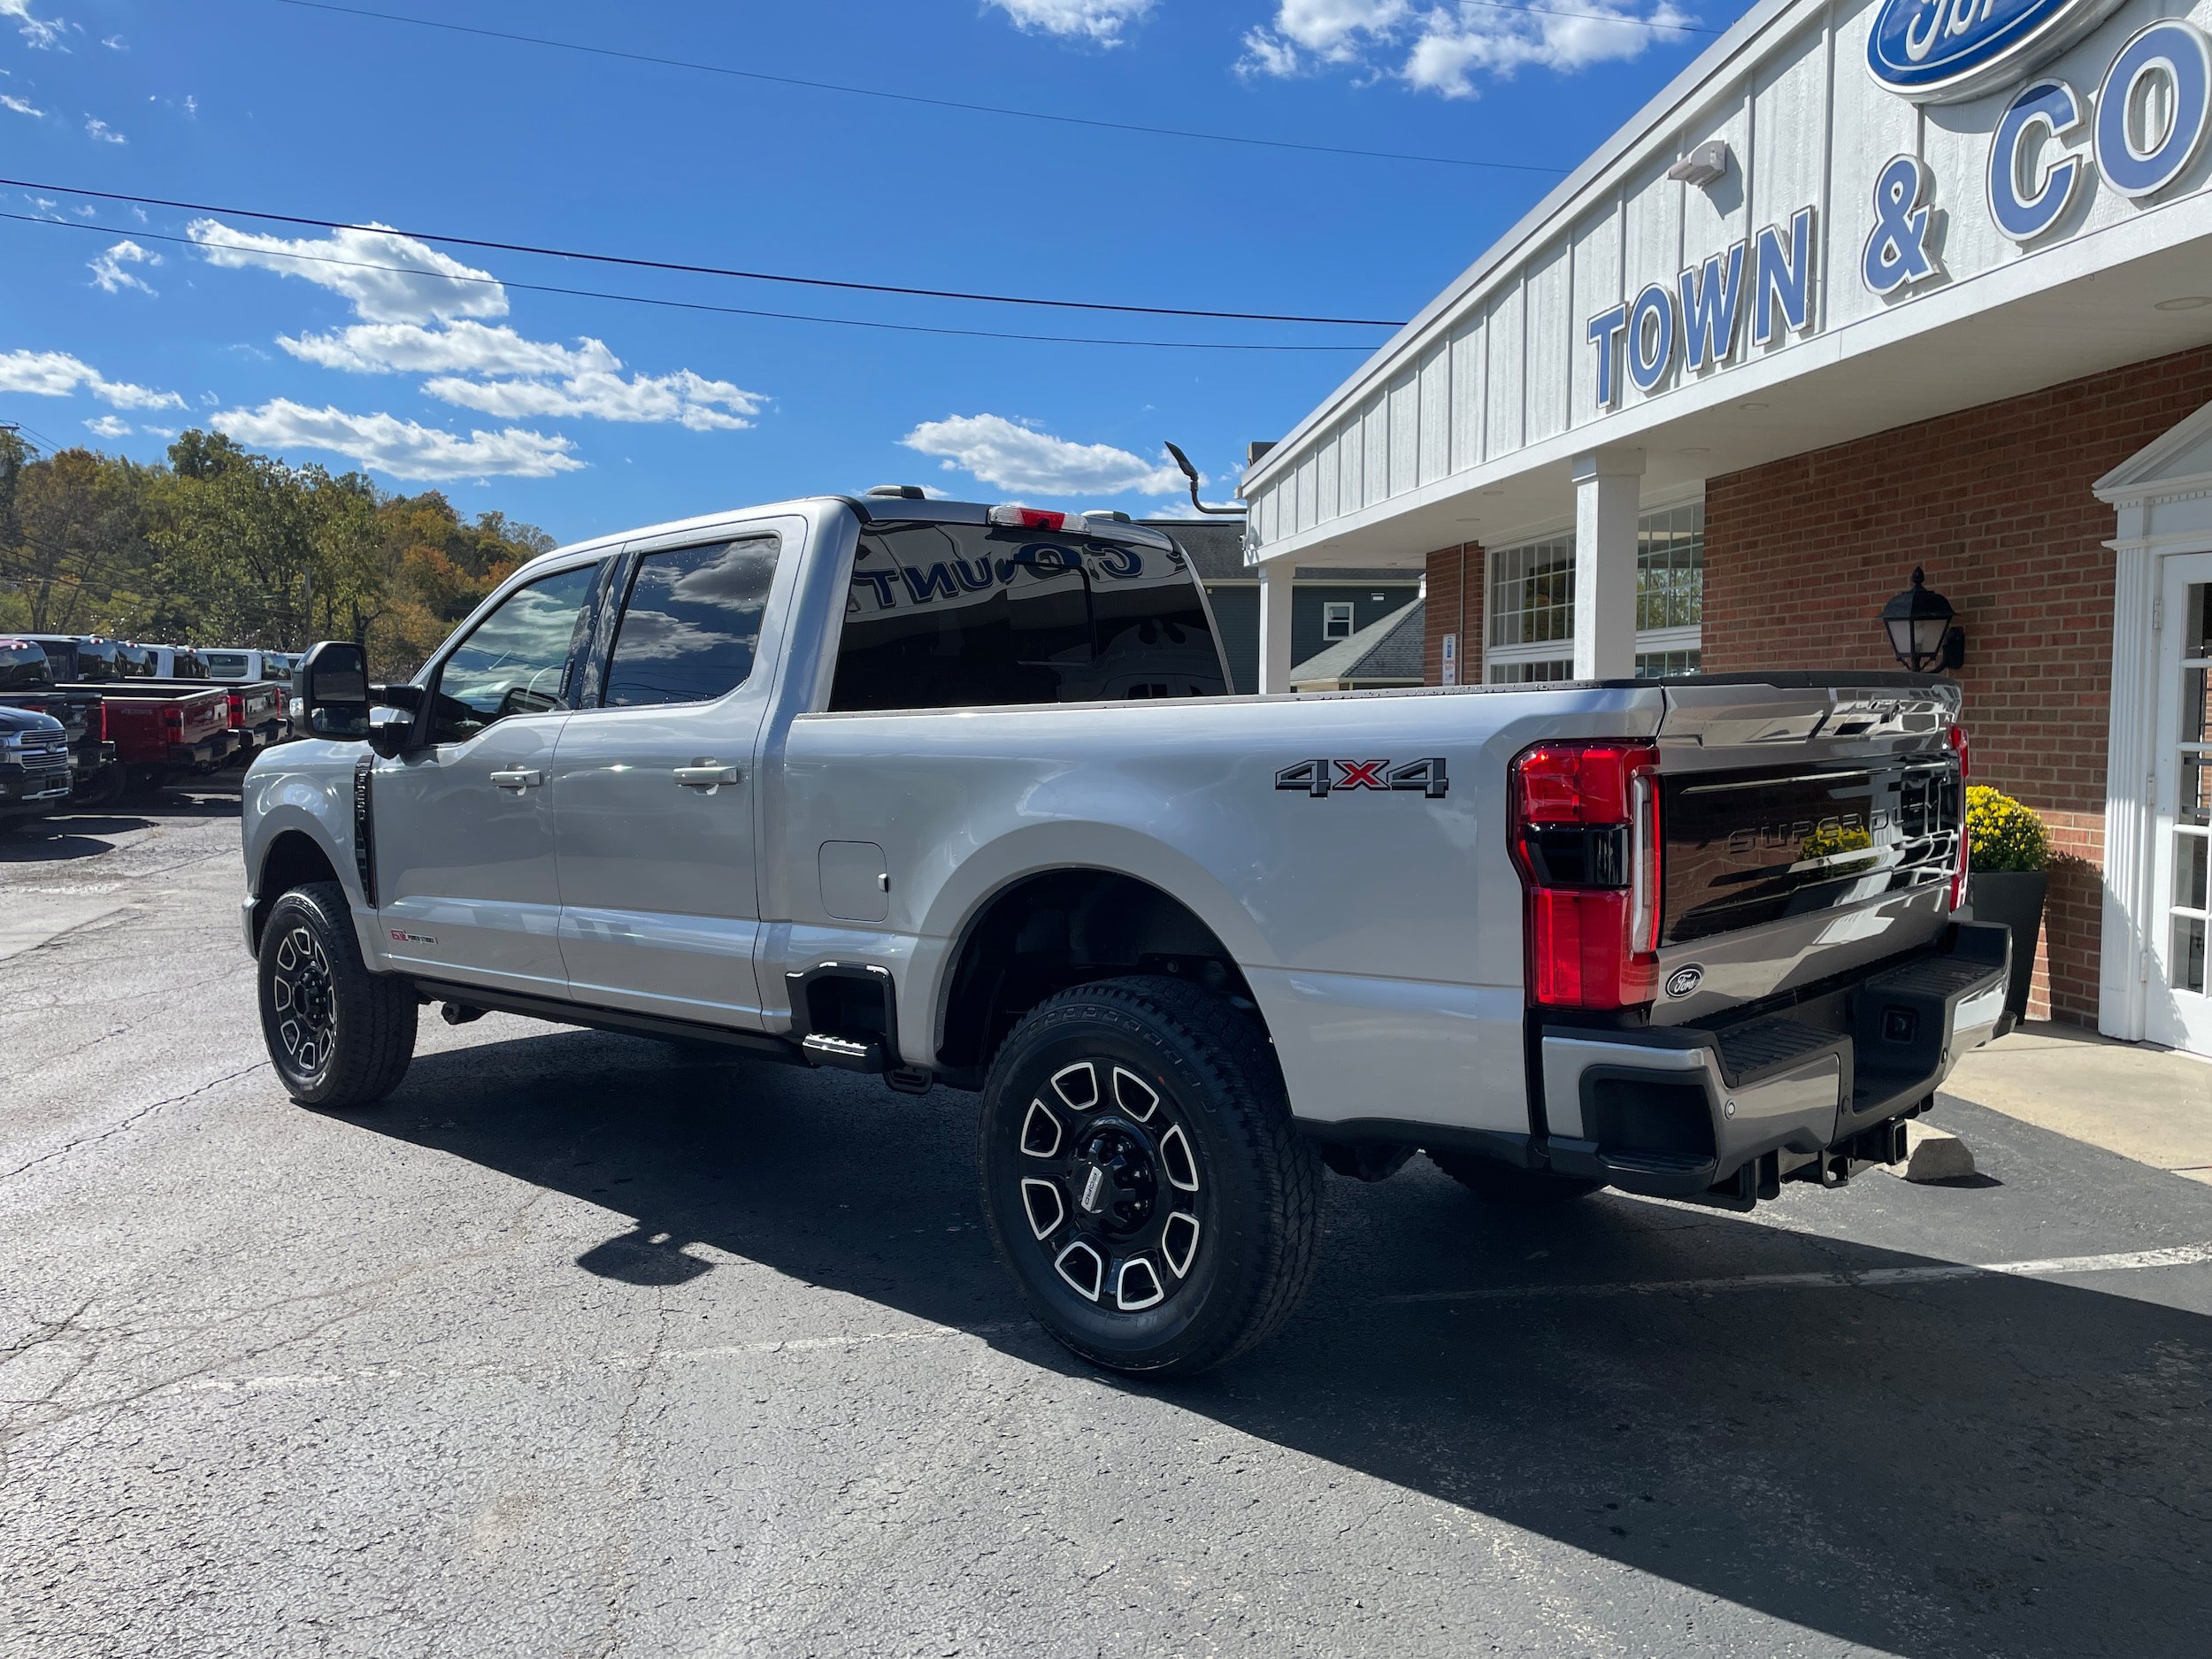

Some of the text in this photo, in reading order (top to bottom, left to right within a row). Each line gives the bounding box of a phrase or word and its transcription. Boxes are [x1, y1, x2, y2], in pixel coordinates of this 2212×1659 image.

[1587, 17, 2211, 409] TOWN & CO
[1275, 758, 1448, 798] 4X4
[1729, 812, 1863, 854] SUPER
[1674, 973, 1697, 993] Ford
